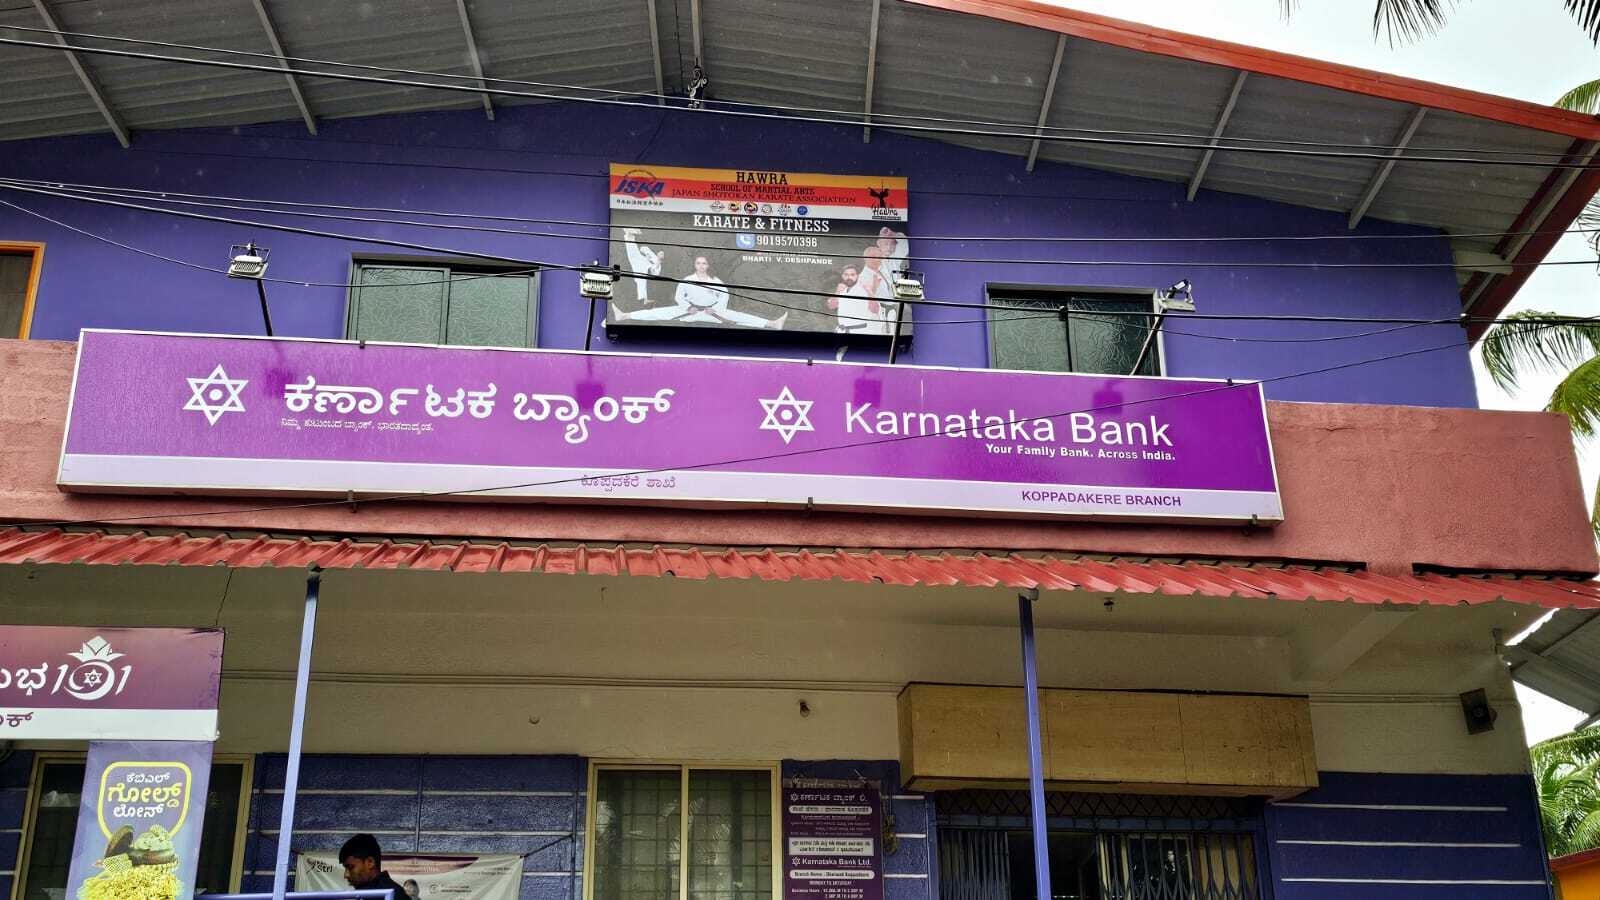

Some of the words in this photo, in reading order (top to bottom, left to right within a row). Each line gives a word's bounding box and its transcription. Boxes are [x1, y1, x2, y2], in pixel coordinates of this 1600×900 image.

[736, 171, 788, 185] HAWRA
[672, 189, 701, 199] JAPAN
[703, 191, 756, 201] SHOTOKAN
[757, 193, 796, 203] KARATE
[796, 195, 857, 205] ASSOCIATION
[710, 184, 740, 193] SCHOOL
[742, 185, 752, 194] OF
[755, 186, 792, 195] MARTIAL
[693, 215, 750, 230] KARATE
[756, 217, 766, 230] &
[770, 218, 830, 232] FITNESS
[757, 235, 817, 248] 9019570396
[742, 255, 772, 263] BHARTI
[785, 256, 833, 265] DESHPANDE
[512, 387, 675, 444] ಬ್ಯಾಂಕ್
[845, 402, 1054, 441] Karnataka
[1071, 412, 1173, 446] Bank
[986, 443, 1012, 455] Your
[1017, 445, 1056, 459] Family
[1060, 447, 1093, 458] Bank.
[1098, 450, 1138, 460] Across
[1143, 451, 1175, 461] India.
[1022, 490, 1122, 505] KOPPADAKERE
[1125, 494, 1181, 506] BRANCH
[113, 804, 164, 818] ಲೋನ್
